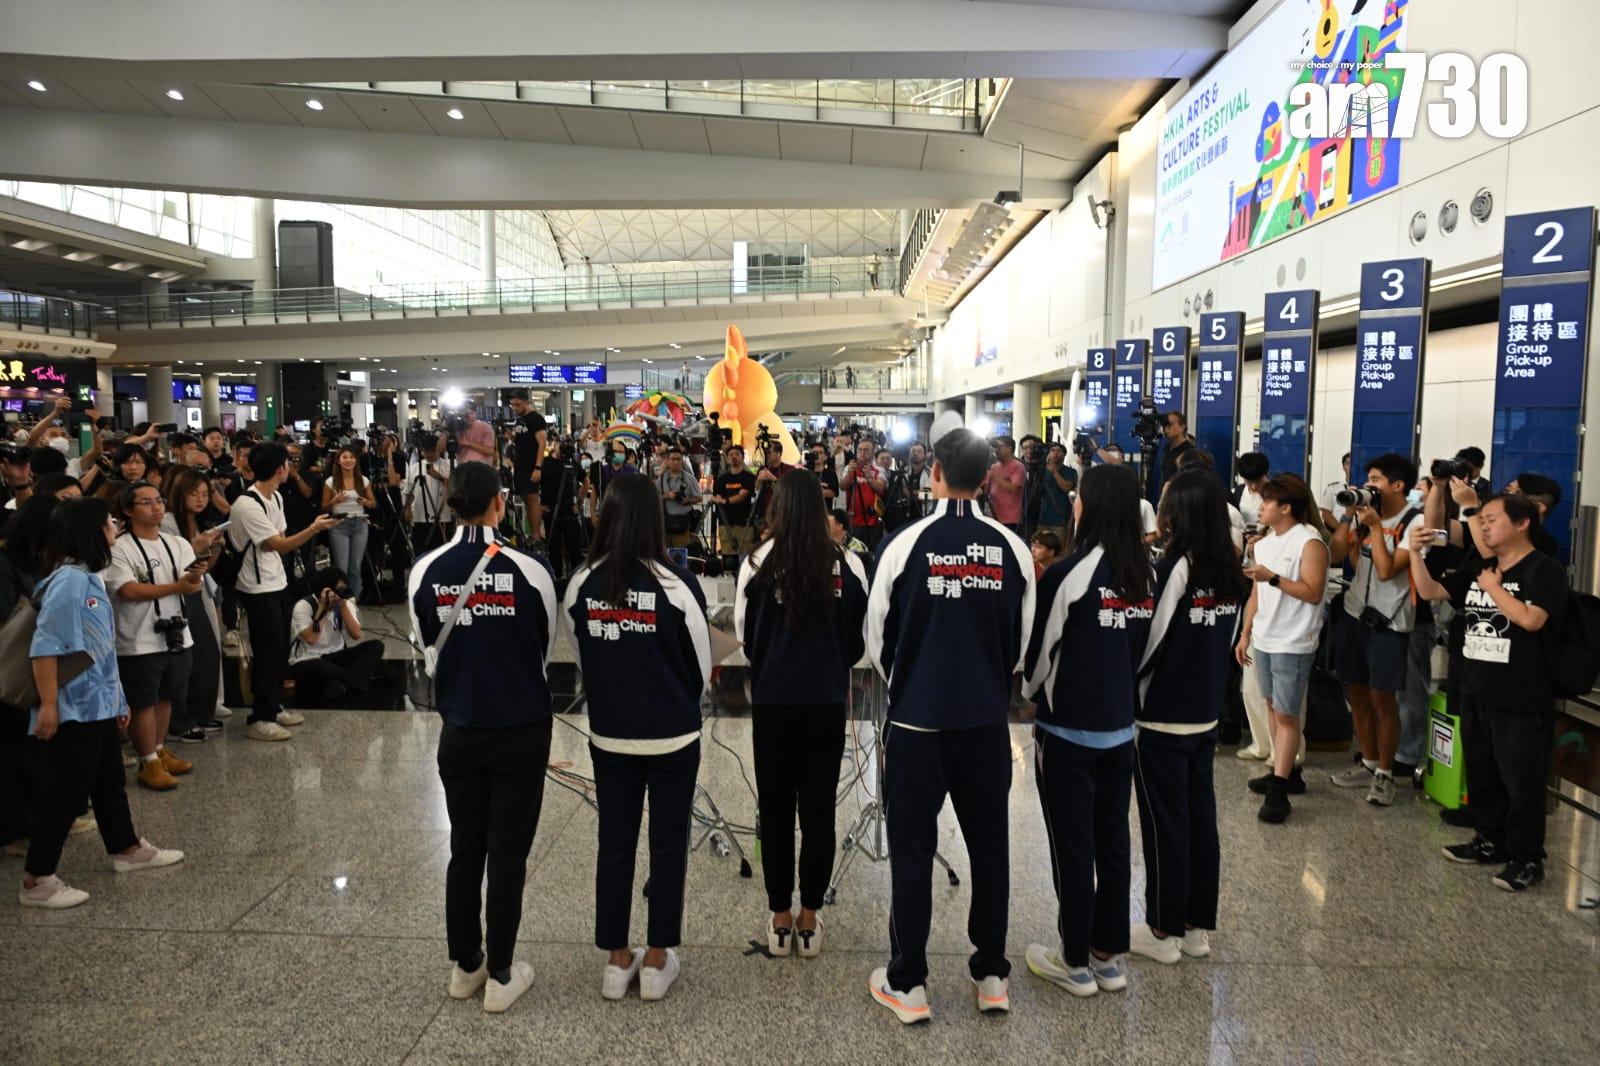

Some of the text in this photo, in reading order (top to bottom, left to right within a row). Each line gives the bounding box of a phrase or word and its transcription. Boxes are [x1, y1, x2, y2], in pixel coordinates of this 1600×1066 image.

[1163, 113, 1184, 145] HKIA
[1187, 88, 1210, 127] ARTS
[1162, 88, 1250, 172] CULTURE FESTIVAL
[1532, 221, 1564, 264] 2
[1380, 268, 1405, 302] 3
[1279, 297, 1299, 324] 4
[1508, 303, 1554, 323] 團體
[1211, 317, 1226, 341] 5
[1507, 321, 1579, 343] 接待區
[1162, 331, 1175, 352] 6
[1363, 331, 1396, 347] 團體
[1124, 343, 1135, 361] 7
[1362, 345, 1414, 361] 接待區
[1506, 343, 1549, 355] Group
[1094, 352, 1104, 368] 8
[1361, 362, 1392, 372] Group
[1505, 355, 1553, 367] Pick-up
[1266, 373, 1290, 382] Group
[1361, 371, 1395, 381] Pick-up
[1504, 367, 1536, 378] Area
[1265, 381, 1292, 390] Pick-up
[1265, 389, 1283, 397] Area
[1360, 381, 1383, 389] Area
[926, 542, 1003, 567] Team 中國
[927, 575, 1003, 598] 香港 China
[472, 603, 516, 616] China
[586, 618, 657, 641] 香港 China
